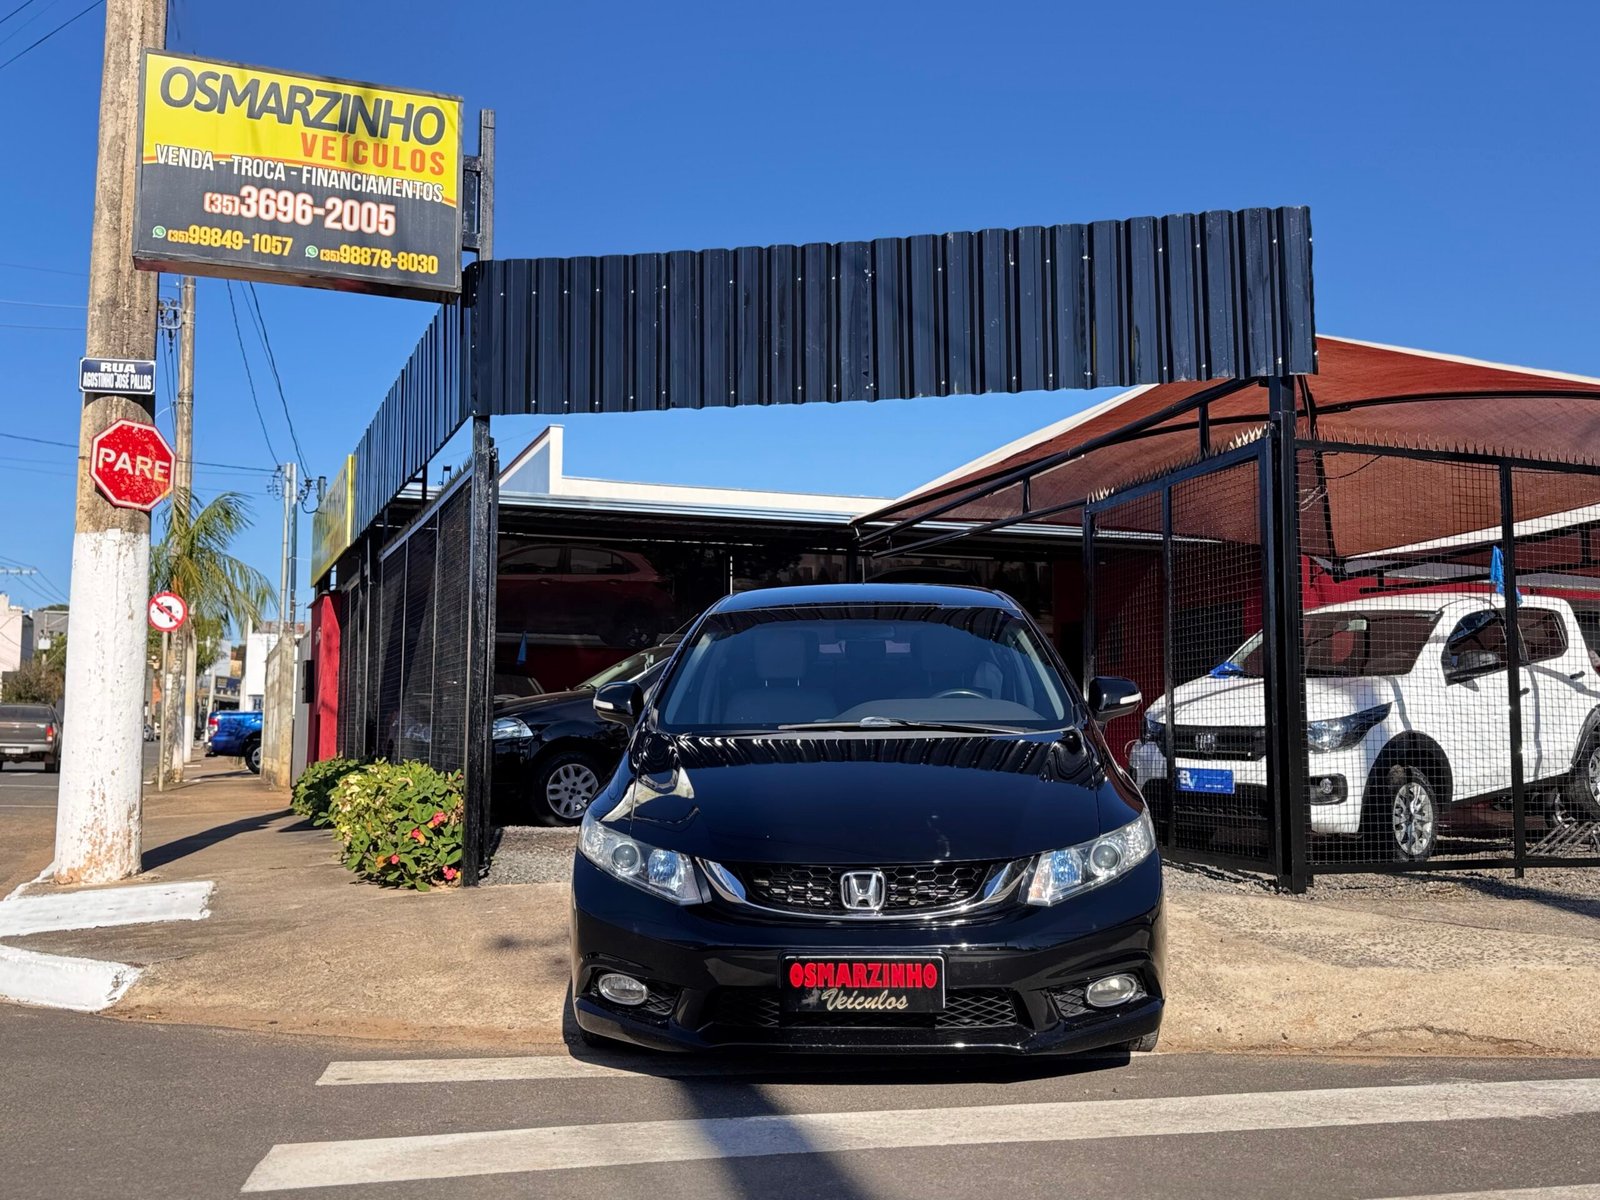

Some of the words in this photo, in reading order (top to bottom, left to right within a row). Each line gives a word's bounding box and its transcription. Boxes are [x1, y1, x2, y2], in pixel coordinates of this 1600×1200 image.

[159, 66, 446, 146] OSMARZINHO
[155, 144, 214, 171] VENDA
[231, 154, 286, 182] TROCA
[302, 165, 444, 203] FINANCIAMENTOS
[300, 131, 445, 176] VEÍCULOS
[203, 184, 396, 237] (35)3696-2005
[100, 362, 136, 373] RUA
[130, 374, 152, 390] PALLOS
[97, 447, 170, 483] PARE
[789, 962, 938, 989] OSMARZINHO
